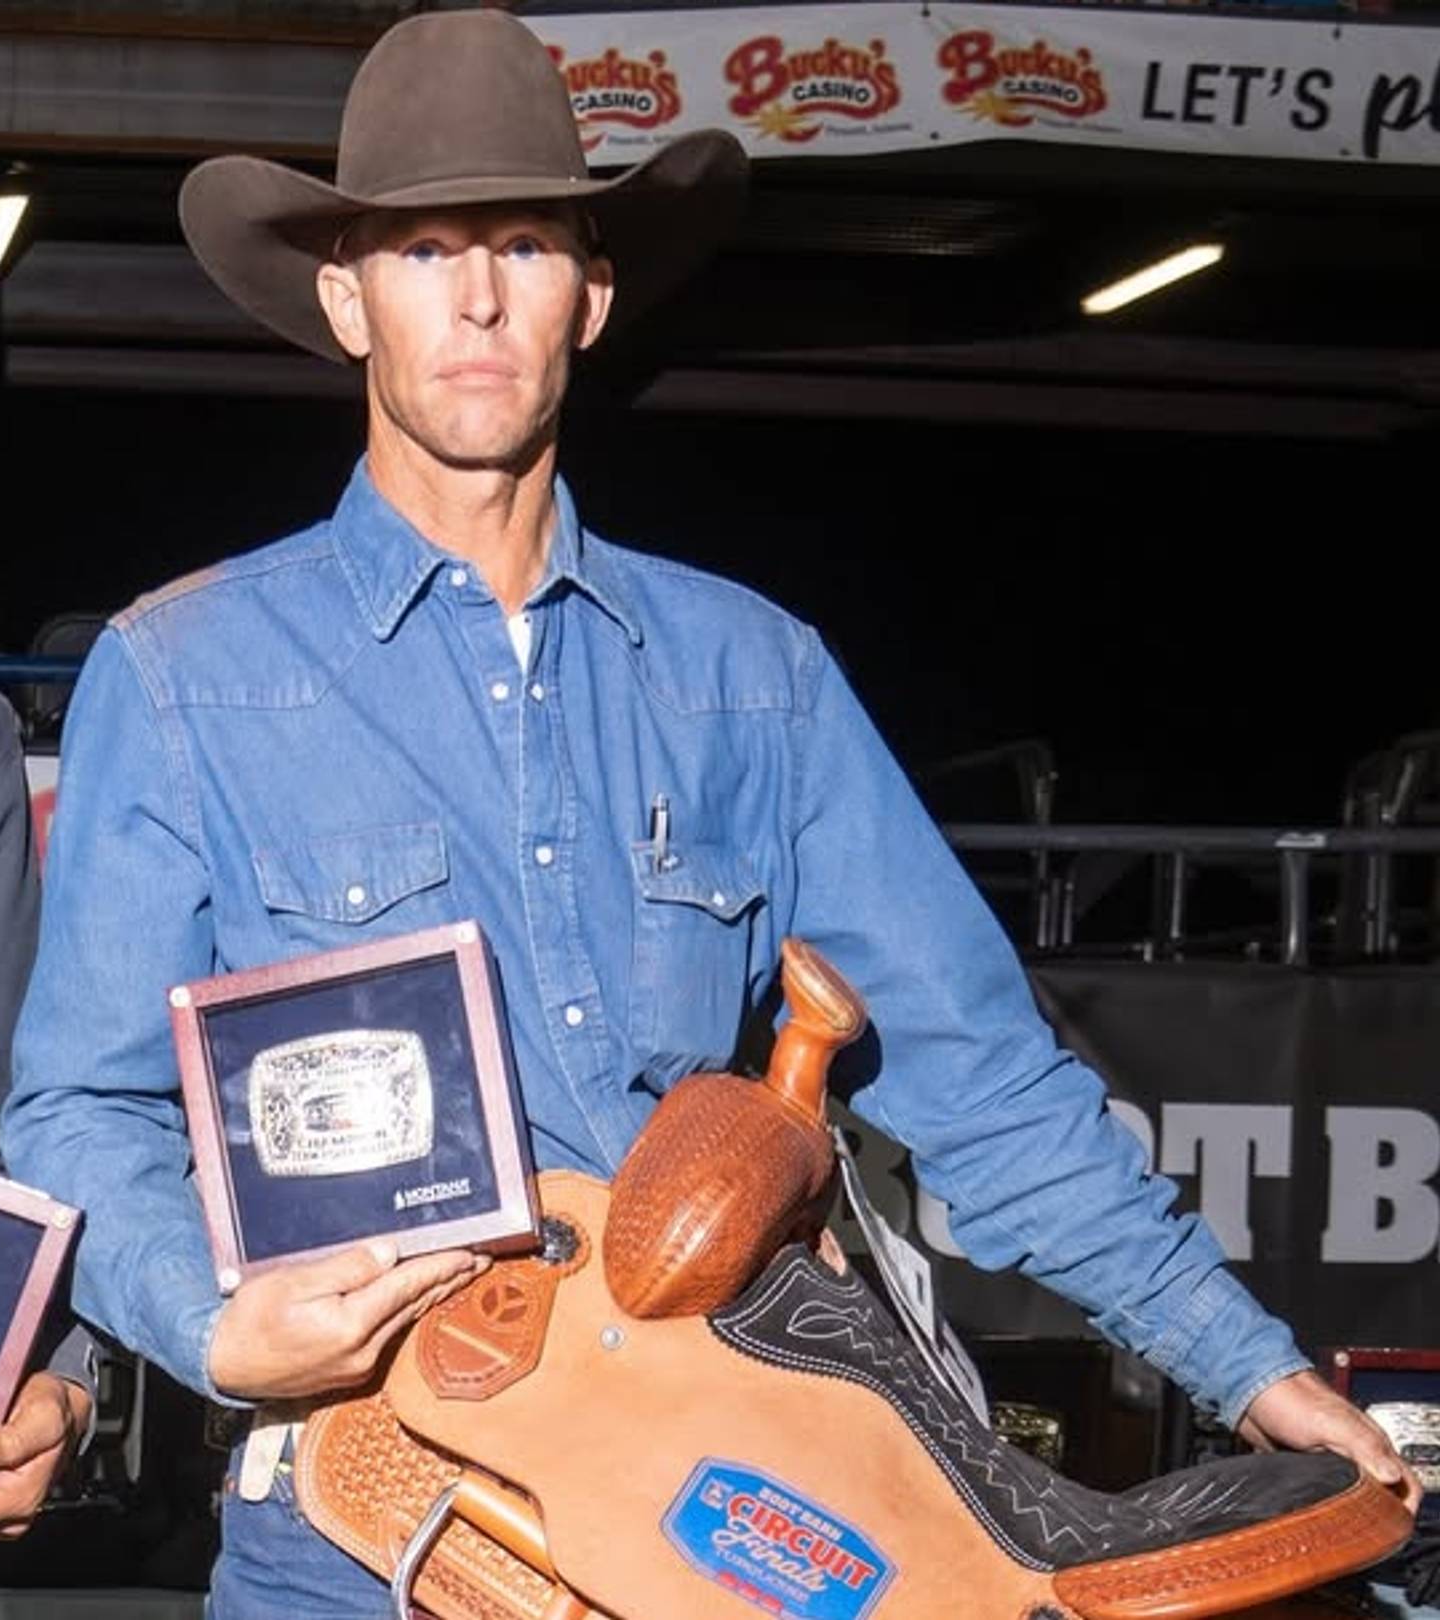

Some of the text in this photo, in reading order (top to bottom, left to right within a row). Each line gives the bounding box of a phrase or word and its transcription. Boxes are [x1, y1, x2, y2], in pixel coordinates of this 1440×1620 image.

[546, 46, 682, 128] ucky's
[571, 93, 652, 112] CASINO
[723, 34, 902, 118] Bucky's
[792, 81, 870, 103] CASINO
[1003, 80, 1078, 103] CASINO
[1142, 61, 1333, 131] LET'S
[712, 1517, 828, 1592] Finals
[727, 1494, 877, 1590] CIRCUIT
